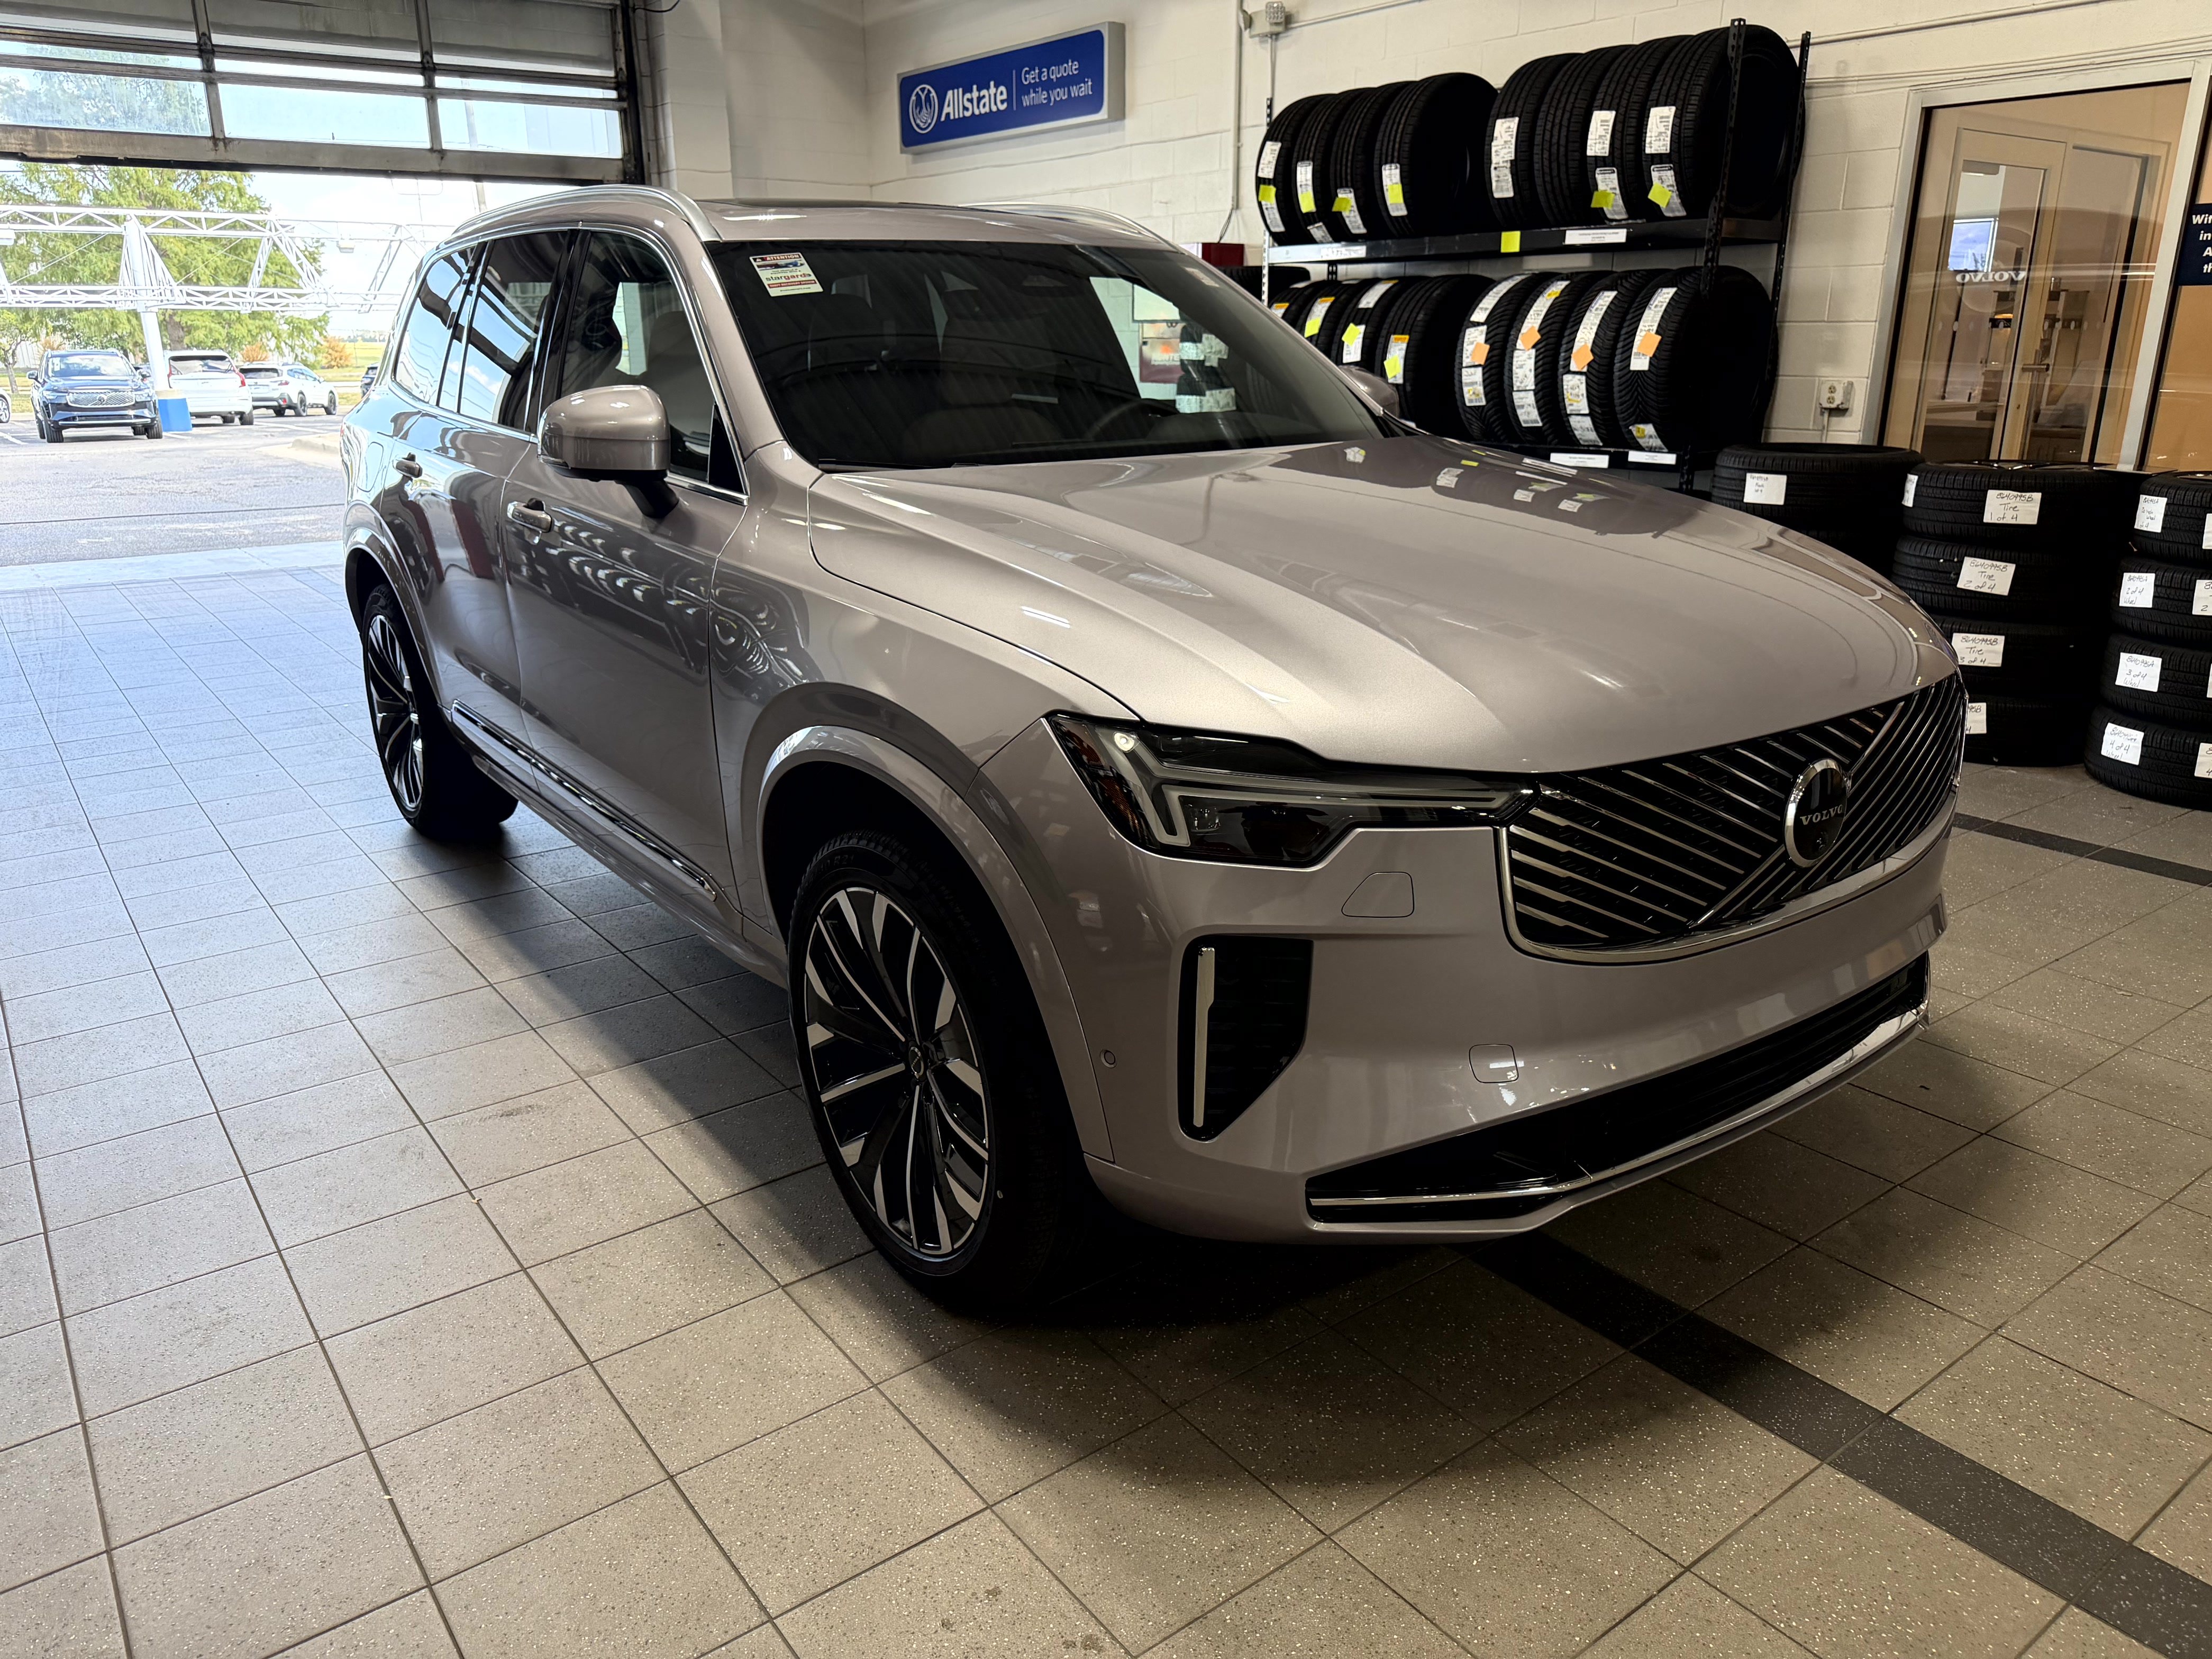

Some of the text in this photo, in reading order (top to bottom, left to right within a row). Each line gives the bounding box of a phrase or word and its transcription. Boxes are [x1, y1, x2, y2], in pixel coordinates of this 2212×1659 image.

[1022, 59, 1079, 85] Get a quote
[1022, 78, 1093, 107] while you wait
[940, 80, 1008, 122] Allstate
[2199, 230, 2211, 241] in
[1999, 502, 2019, 512] Tire
[1990, 512, 2018, 522] 1 of 4
[1978, 571, 1996, 581] Tire
[1974, 581, 1987, 590] of
[1988, 583, 1996, 592] 4
[1965, 646, 1984, 655] Tire
[2110, 740, 2115, 749] 4
[2124, 744, 2130, 754] 4
[1800, 804, 1843, 825] VOLVO
